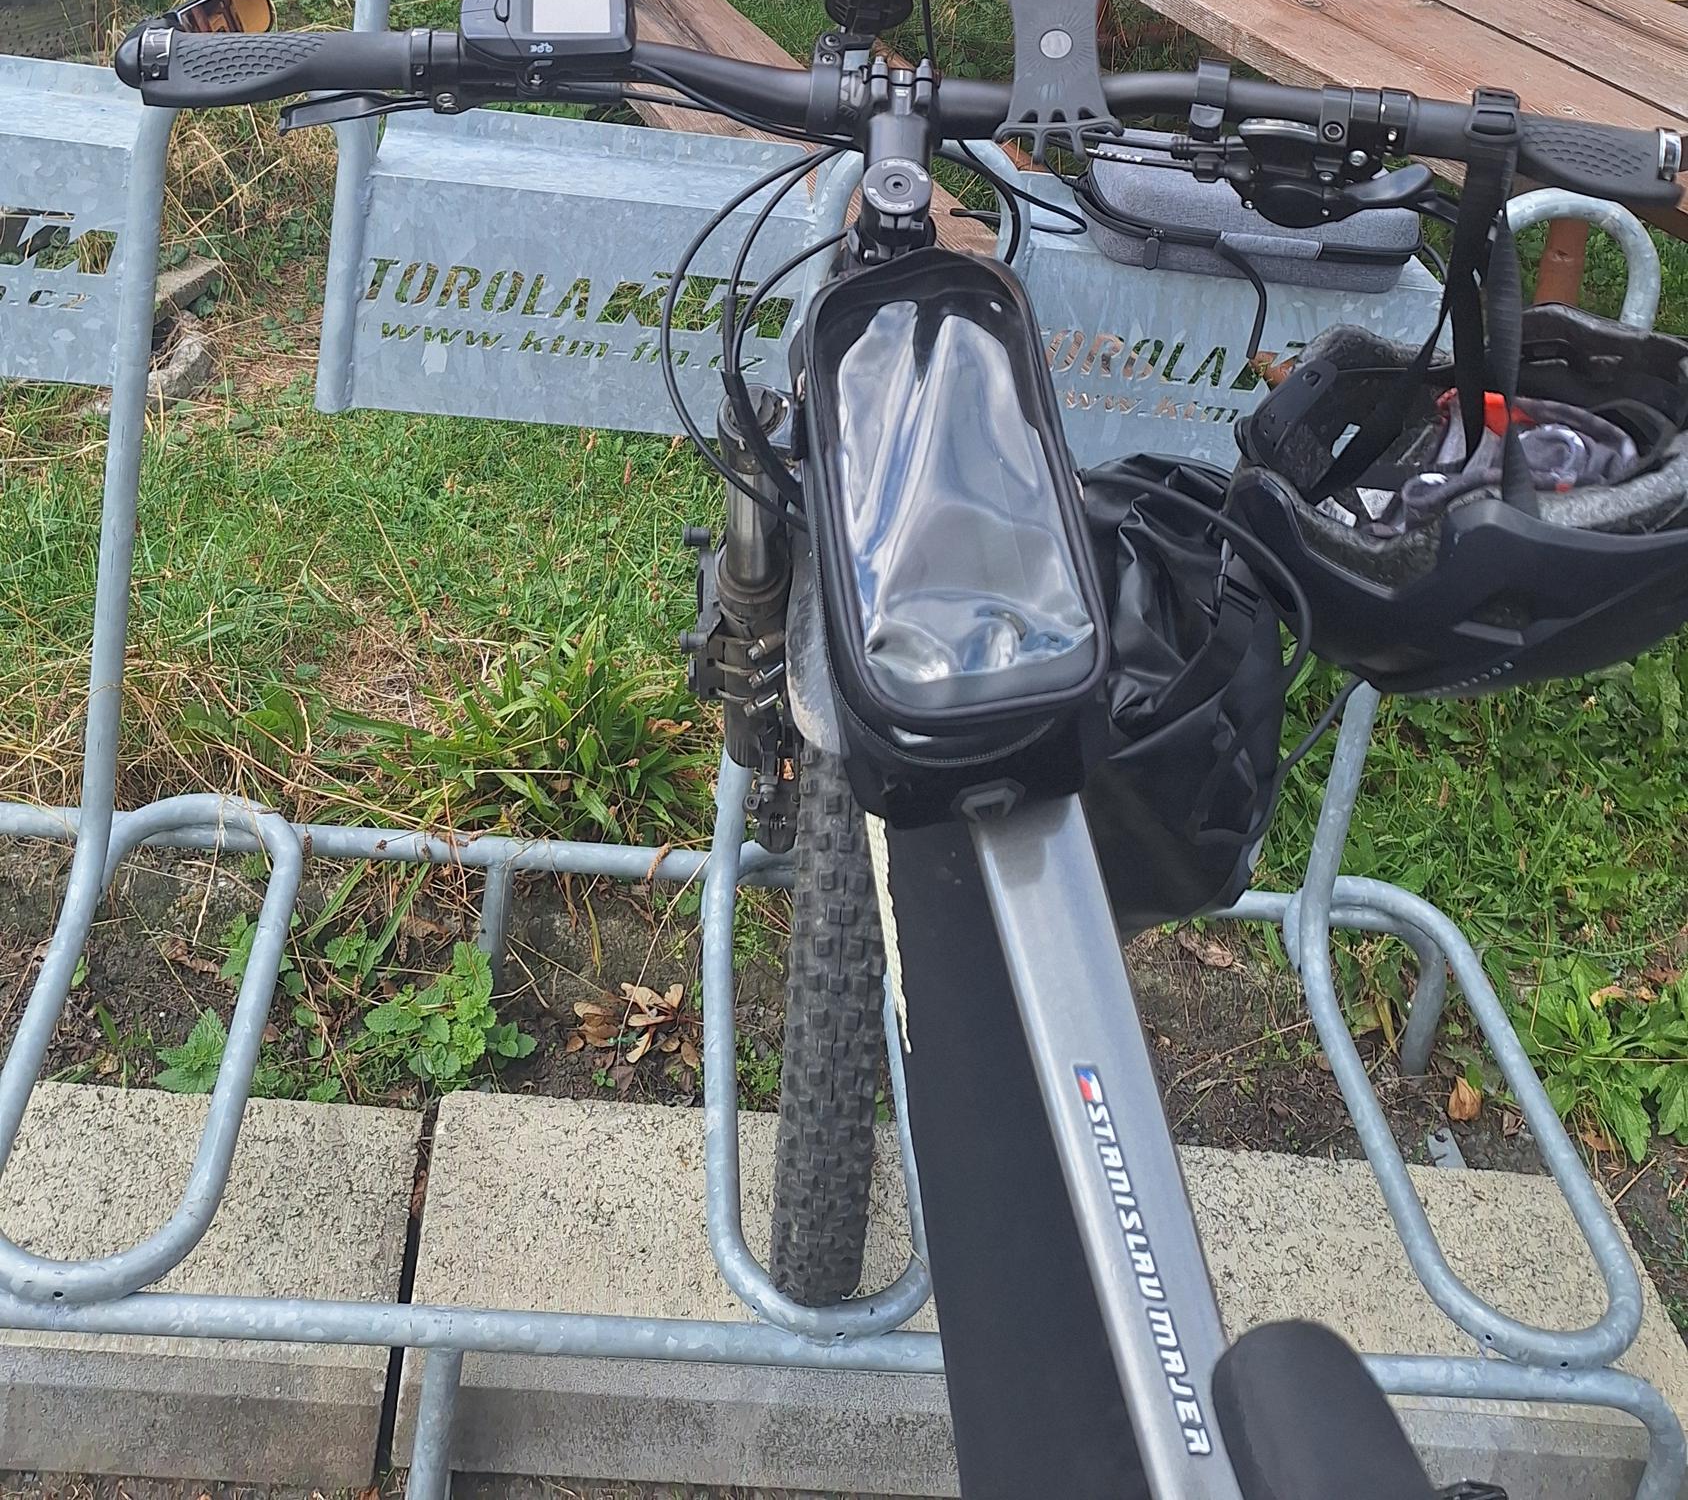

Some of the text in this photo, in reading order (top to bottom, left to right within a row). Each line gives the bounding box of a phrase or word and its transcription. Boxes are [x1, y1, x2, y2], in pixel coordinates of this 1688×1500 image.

[365, 257, 796, 340] TOROLA KTM
[1040, 327, 1228, 389] OROLA
[1146, 1307, 1213, 1457] MAJER
